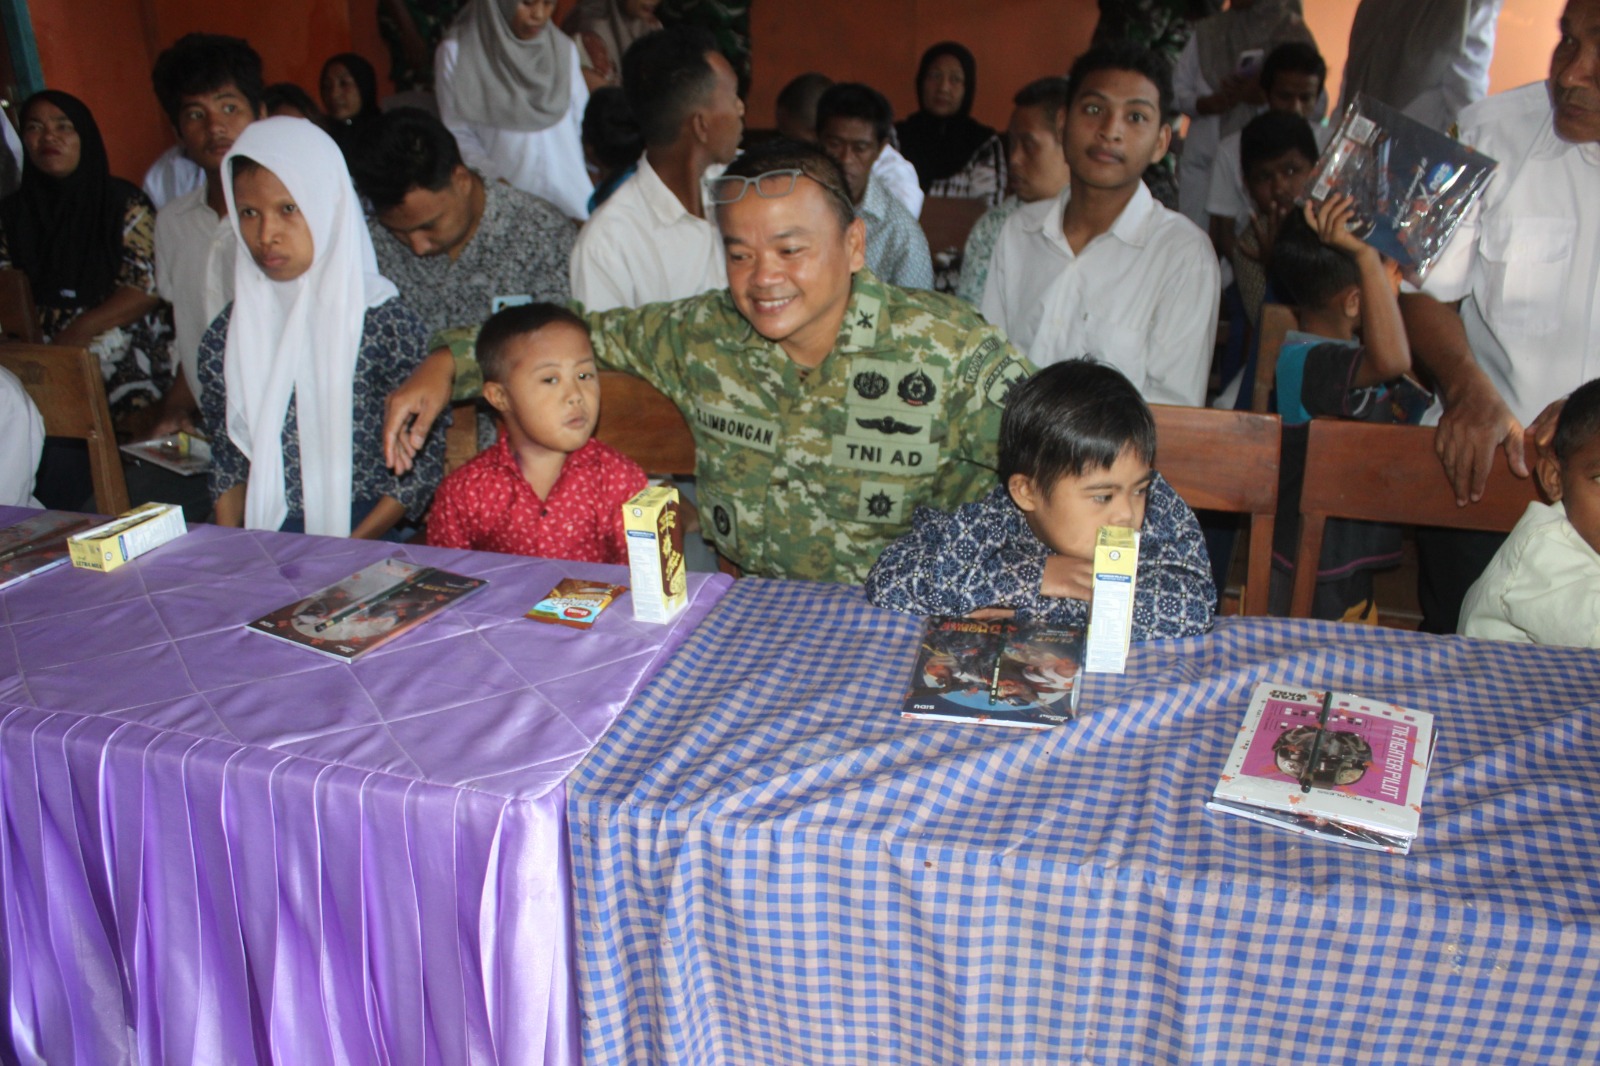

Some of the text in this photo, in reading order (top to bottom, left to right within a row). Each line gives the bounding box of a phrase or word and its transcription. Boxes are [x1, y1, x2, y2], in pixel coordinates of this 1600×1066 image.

[966, 352, 985, 383] KODIM
[846, 443, 923, 467] TNI AD
[1380, 769, 1401, 800] PILOT
